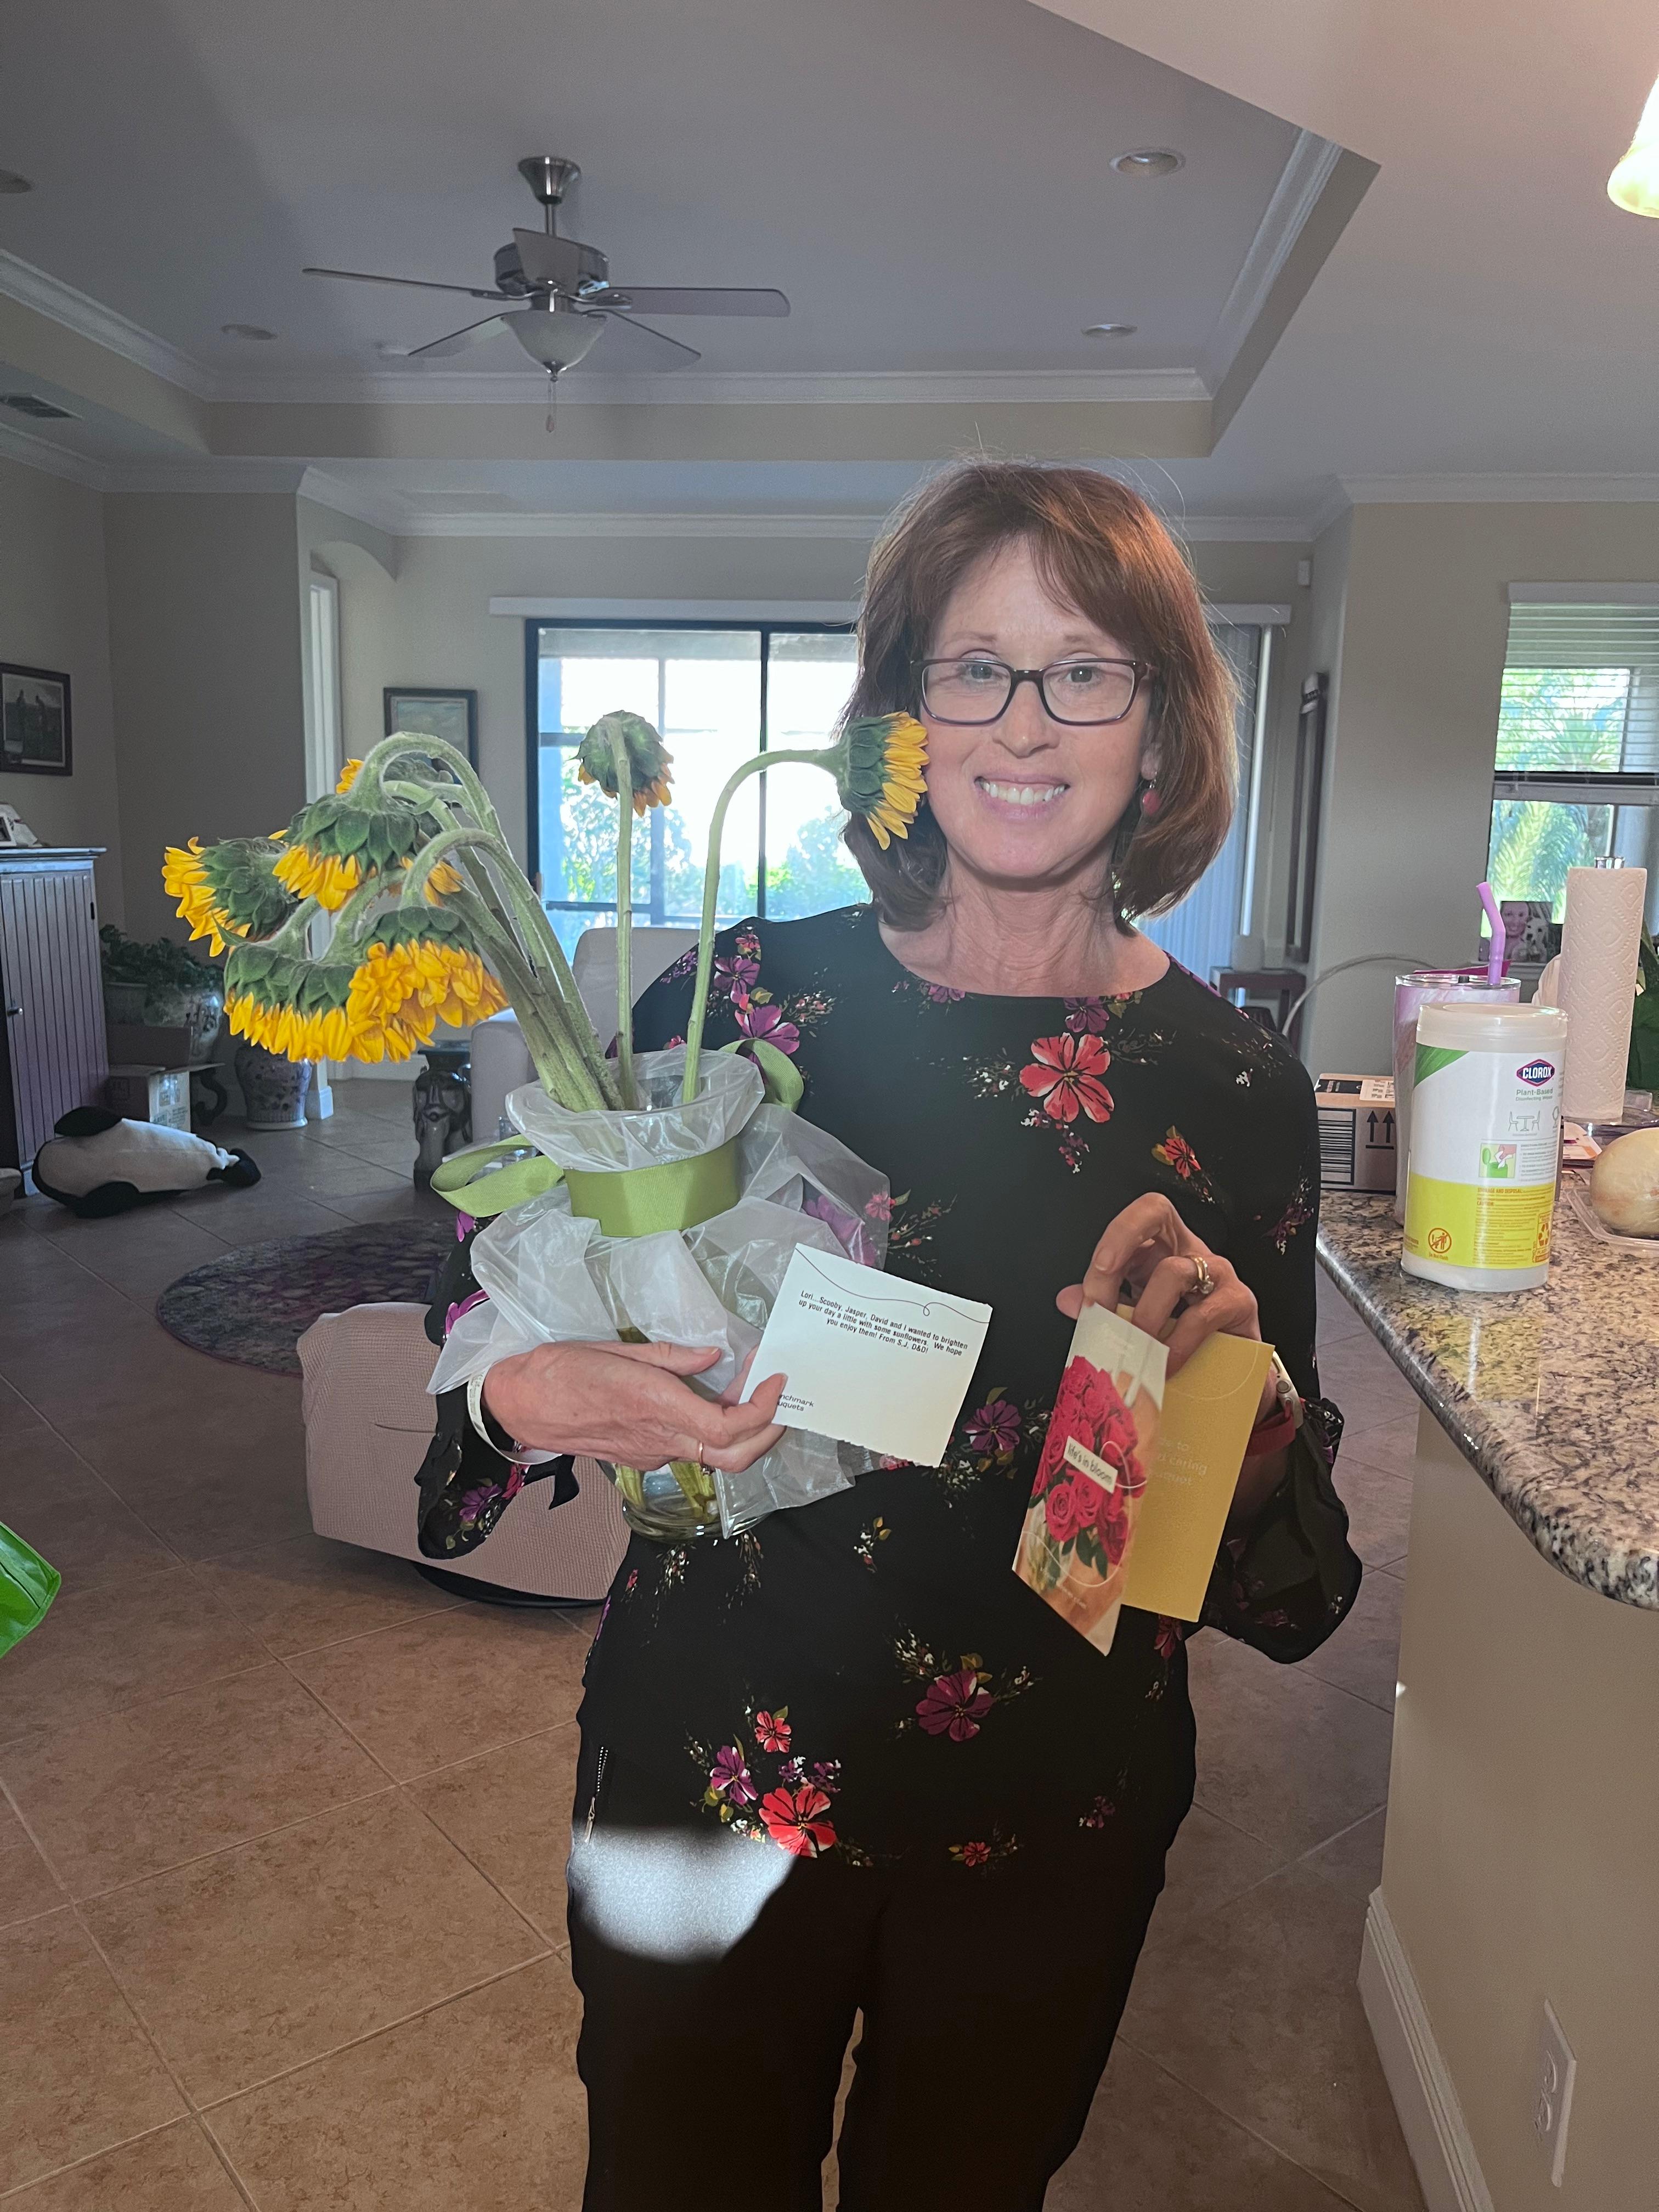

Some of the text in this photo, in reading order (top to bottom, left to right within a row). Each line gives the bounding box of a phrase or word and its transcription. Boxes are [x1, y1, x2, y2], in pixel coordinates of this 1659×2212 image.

[1522, 1066, 1552, 1079] CLOROX
[1516, 1087, 1553, 1096] Plant-Based
[808, 1302, 823, 1312] your
[824, 1307, 836, 1317] day
[843, 1313, 857, 1323] little
[859, 1319, 873, 1329] with
[874, 1325, 891, 1334] some
[893, 1330, 929, 1346] sunflowers.
[934, 1342, 944, 1351] We
[946, 1346, 962, 1356] hope
[826, 1318, 838, 1326] you
[840, 1322, 857, 1333] enjoy
[859, 1327, 877, 1338] them!
[879, 1334, 896, 1344] From
[911, 1344, 929, 1354] D&D!
[870, 1314, 889, 1325] David
[909, 1327, 931, 1338] wanted
[941, 1336, 968, 1350] brighten
[777, 1401, 804, 1412] uquets
[779, 1394, 814, 1407] nchmark
[1090, 1457, 1113, 1485] bloom
